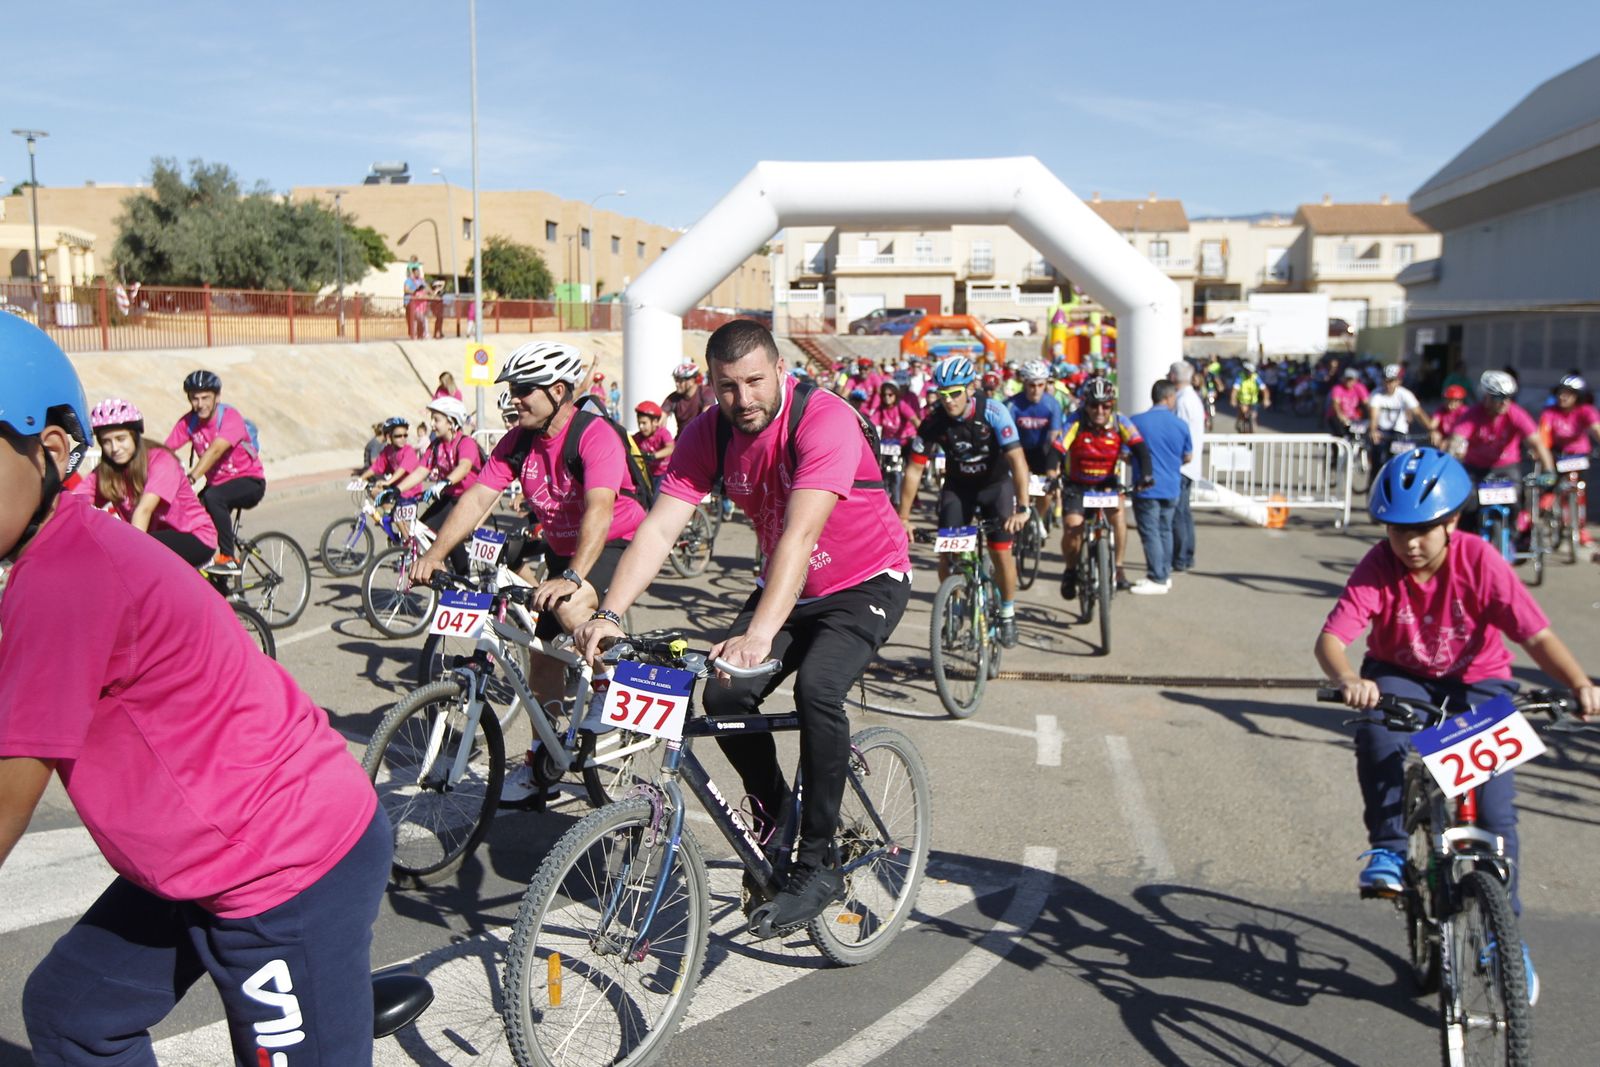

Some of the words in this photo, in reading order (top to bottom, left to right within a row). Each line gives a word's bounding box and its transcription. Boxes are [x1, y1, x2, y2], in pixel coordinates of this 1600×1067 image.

[474, 542, 496, 560] 108
[940, 539, 969, 549] 482
[809, 551, 829, 565] ETA
[812, 556, 832, 571] 2019
[437, 610, 479, 633] 047
[610, 691, 676, 730] 377
[1440, 726, 1523, 787] 265
[706, 779, 726, 806] BH
[726, 801, 746, 831] TOP
